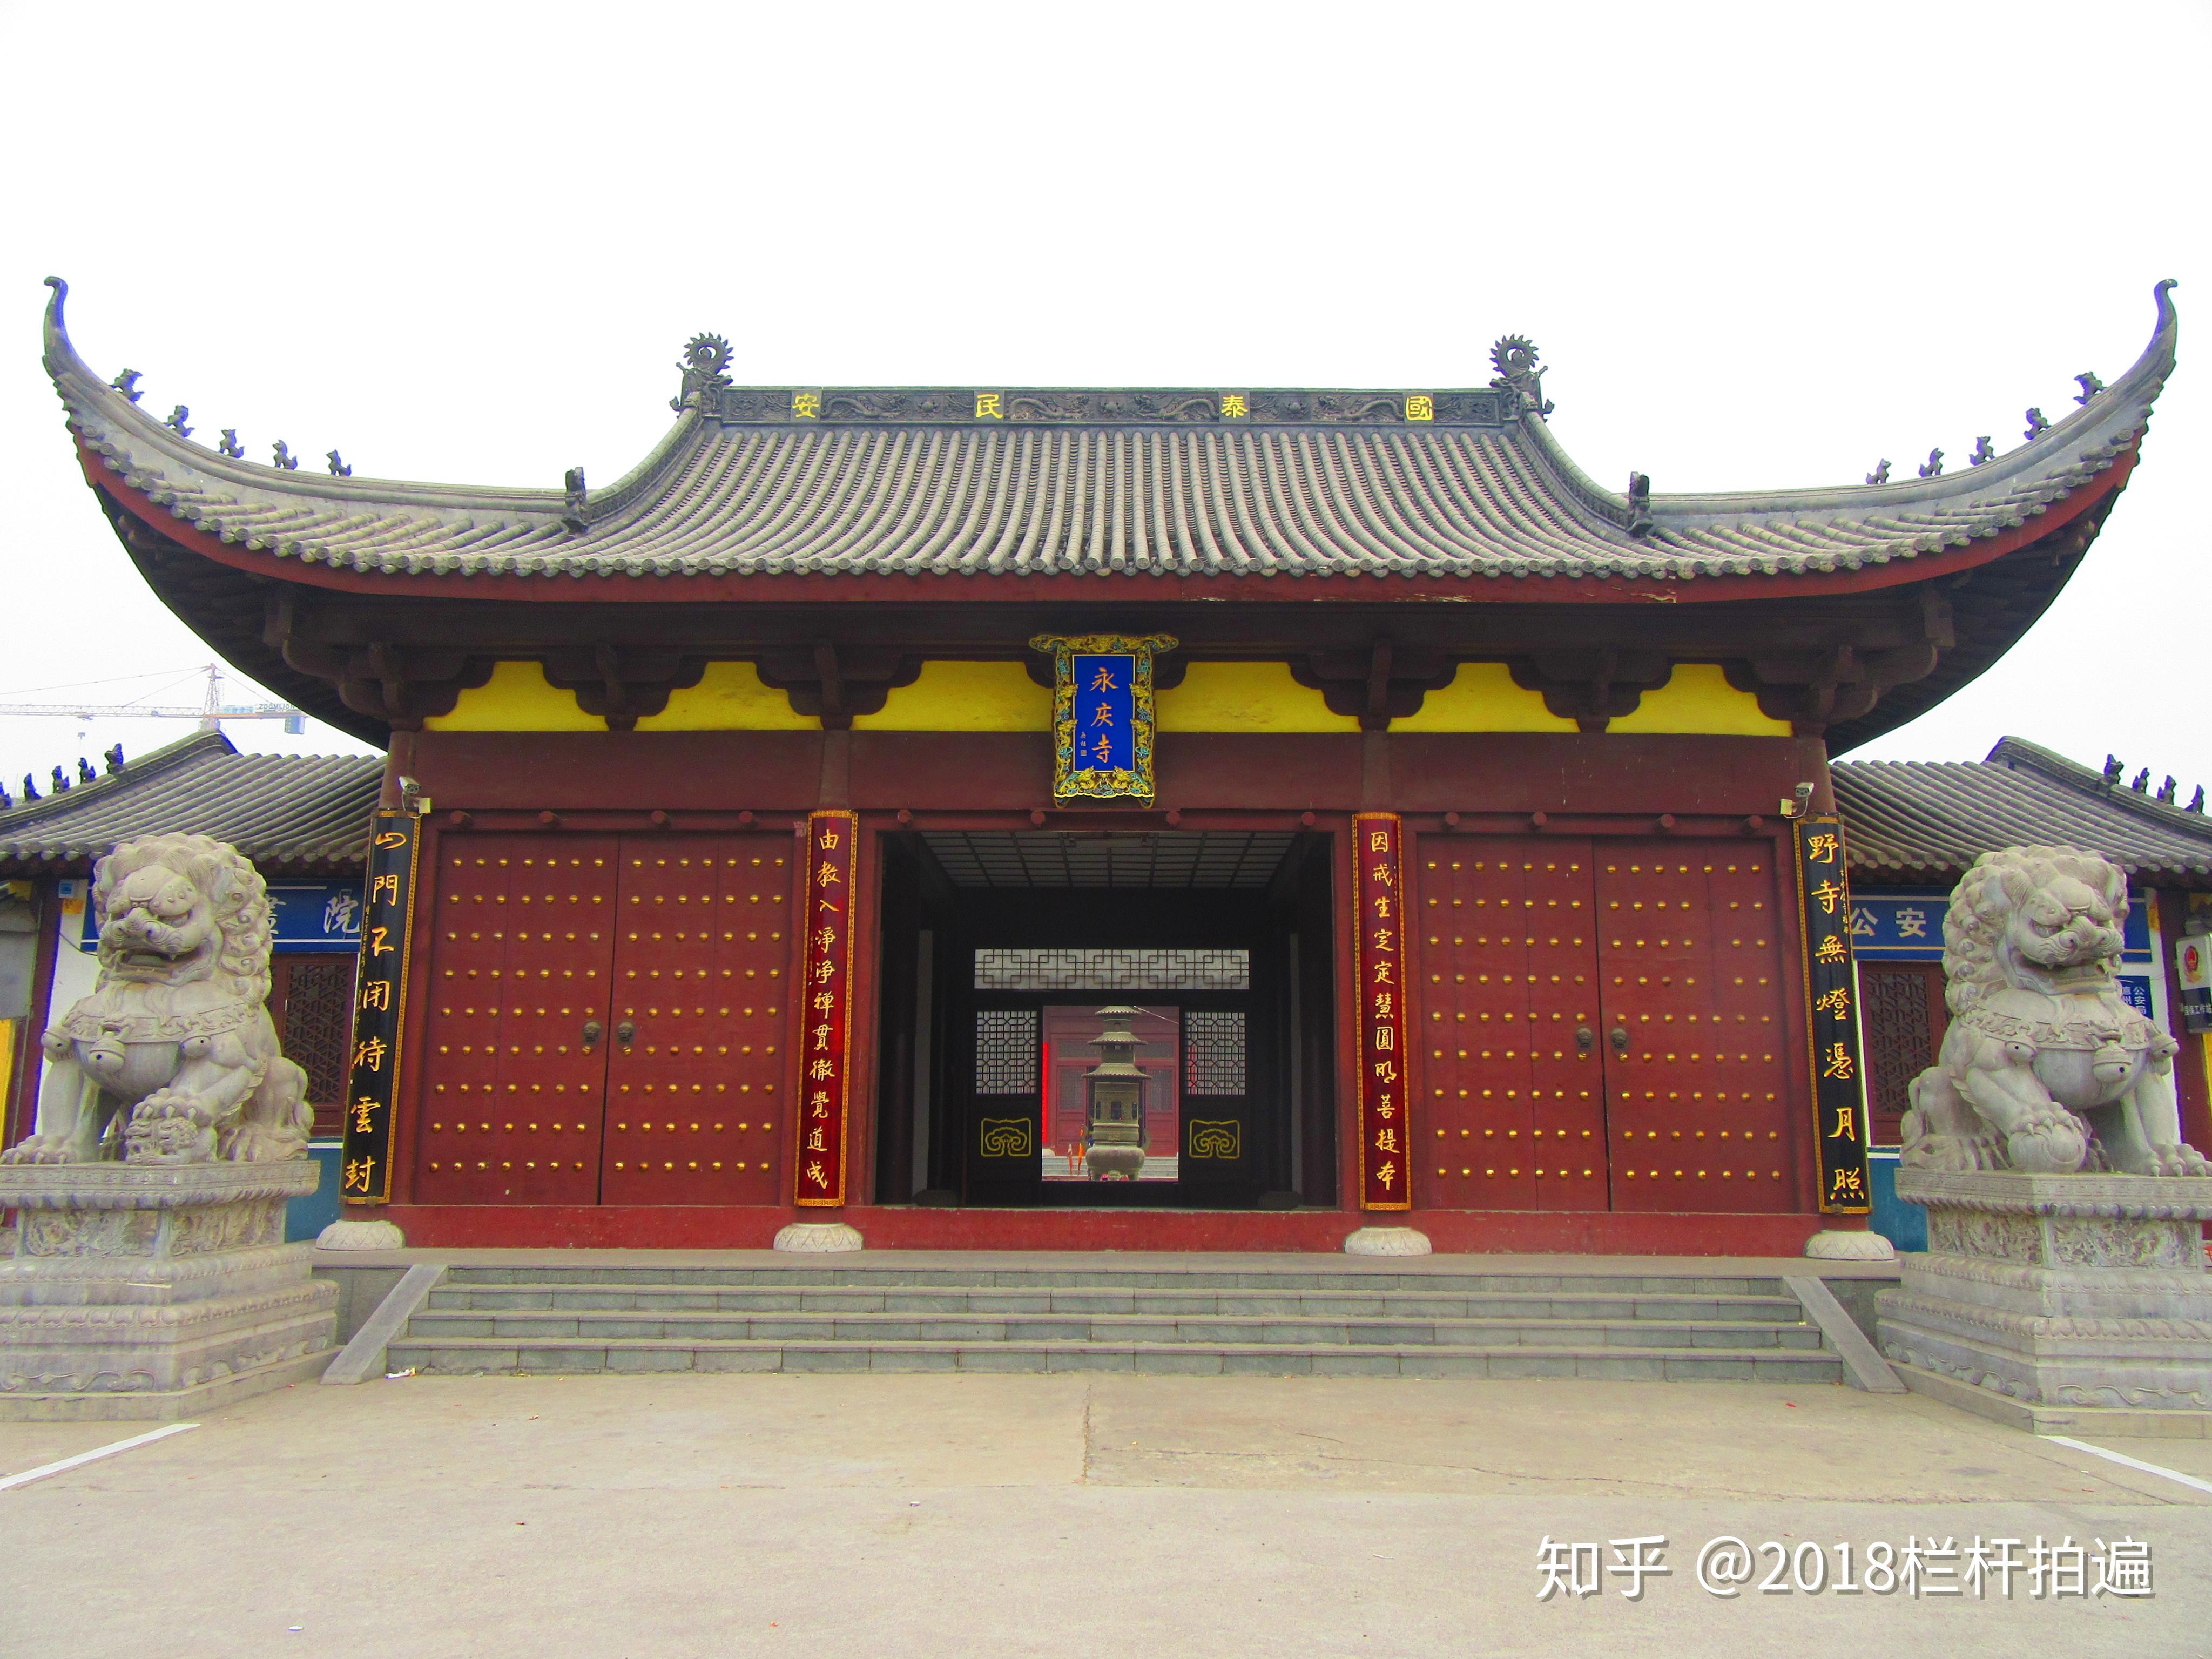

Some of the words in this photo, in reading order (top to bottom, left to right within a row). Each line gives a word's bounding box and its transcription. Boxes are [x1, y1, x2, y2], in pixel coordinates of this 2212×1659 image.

[1089, 666, 1119, 763] 永庆寺
[1850, 907, 1927, 938] 公安
[2133, 986, 2147, 1015] 公安局
